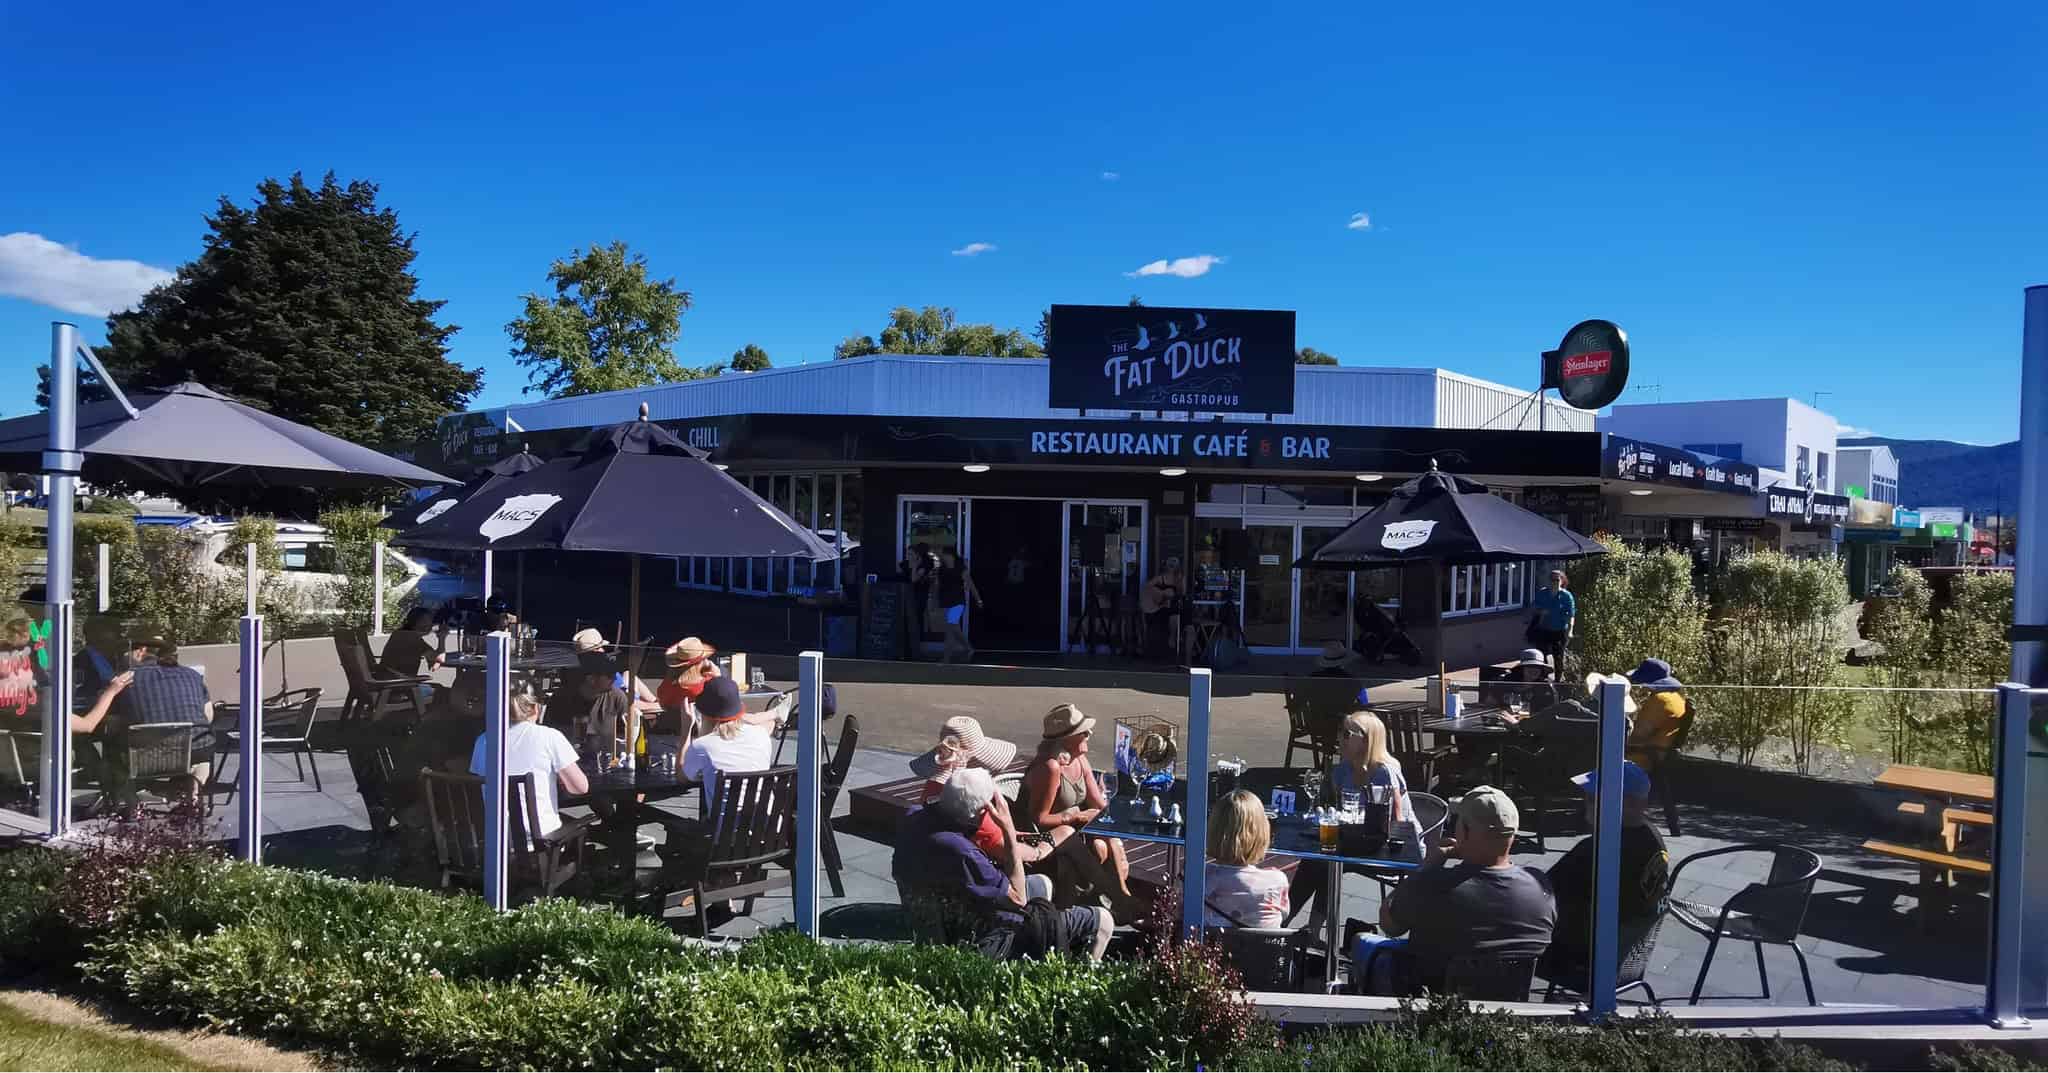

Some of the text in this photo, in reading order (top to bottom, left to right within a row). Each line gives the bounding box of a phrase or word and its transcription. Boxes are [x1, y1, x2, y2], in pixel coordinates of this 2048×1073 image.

[1111, 343, 1129, 353] THE
[1104, 337, 1242, 396] FAT DUCK
[1170, 393, 1239, 407] GASTROPUB
[689, 426, 720, 448] CHILL
[1031, 431, 1184, 457] RESTAURANT
[1192, 429, 1248, 457] CAFÉ
[1281, 436, 1330, 459] BAR
[1275, 793, 1290, 811] 41
